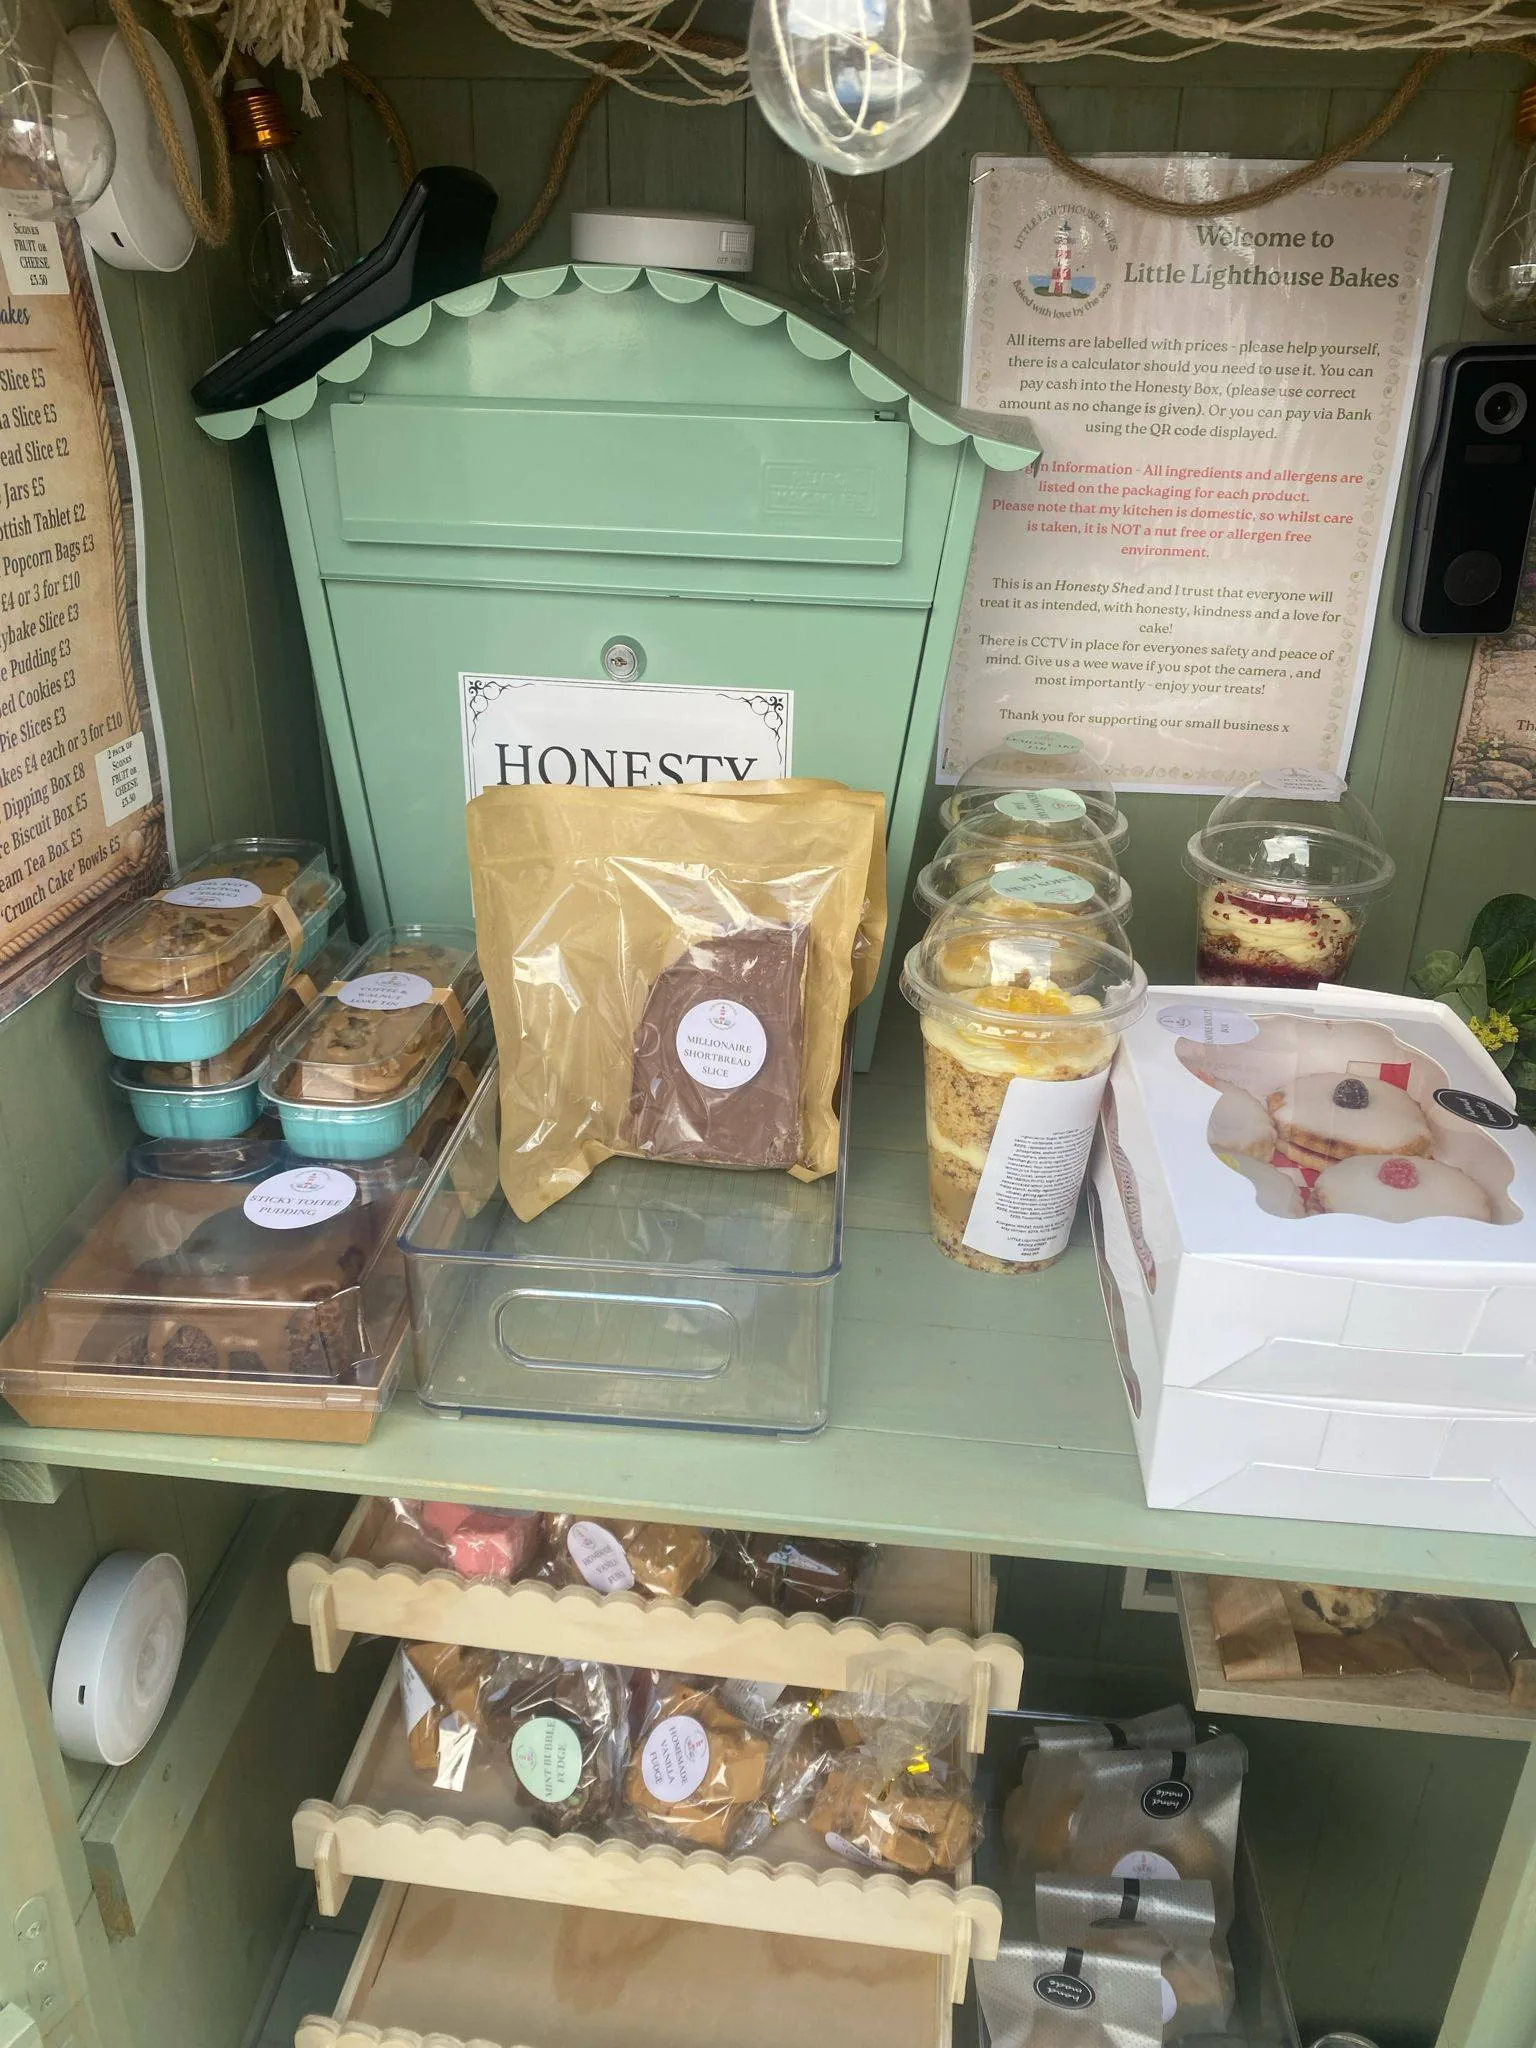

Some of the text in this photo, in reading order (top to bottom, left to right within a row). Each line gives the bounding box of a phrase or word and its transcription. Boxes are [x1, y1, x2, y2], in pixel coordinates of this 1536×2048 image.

[1196, 225, 1334, 248] Welcome to
[20, 256, 50, 268] CHEESE
[1124, 263, 1399, 288] Little Lighthouse Bakes
[1013, 280, 1112, 319] Baked with love by the sea
[1005, 332, 1380, 357] All items are labelled with prices please help yourself,
[0, 367, 46, 392] Slice £5
[1019, 377, 1356, 398] pay cash into the Honesty Box, (please use correct
[12, 403, 57, 428] Slice £5
[1084, 421, 1277, 440] using the QR code displayed.
[25, 440, 53, 463] Slice
[56, 437, 69, 457] £2
[4, 476, 46, 509] Jars £5
[1037, 480, 1310, 502] listed on the packaging for each product.
[34, 507, 71, 532] Tablet
[73, 503, 86, 522] £2
[4, 534, 95, 577] Popcorn Bags £3
[1121, 545, 1209, 558] environment.
[1, 570, 80, 613] £4 or 3 for £10
[0, 603, 79, 653] ybake Slice £3
[1138, 622, 1173, 634] cake!
[10, 638, 71, 678] Pudding £3
[0, 669, 76, 717] ed Cookies £3
[1034, 675, 1266, 695] most importantly enjoy your treats!
[0, 706, 66, 753] Pie Slices £3
[998, 708, 1290, 733] Thank you for supporting our small business x
[1516, 719, 1536, 731] Th
[25, 753, 38, 775] £4
[40, 740, 66, 767] each
[67, 737, 79, 753] or
[80, 729, 88, 746] 3
[89, 723, 104, 742] for
[106, 711, 123, 733] £10
[495, 743, 758, 787] HONESTY
[5, 762, 86, 820] Dipping Box £8
[115, 777, 139, 797] CHEESE
[11, 815, 52, 852] Biscuit
[53, 803, 75, 827] Box
[75, 792, 88, 813] £5
[24, 854, 46, 877] Tea
[49, 839, 71, 863] Box
[71, 828, 83, 848] £5
[78, 844, 108, 875] Bowls
[108, 835, 121, 854] £5
[686, 1035, 753, 1054] MILLIONAIRE
[684, 1049, 751, 1067] SHORTBREAD
[701, 1065, 729, 1078] SLICE
[1455, 1096, 1479, 1118] hand
[249, 1195, 344, 1207] STICKY TOFFEE
[258, 1206, 318, 1216] PUDDING
[543, 1719, 556, 1798] MINT BUBBLE
[556, 1742, 567, 1784] FUDGE
[649, 1751, 664, 1785] FUDGE
[660, 1739, 676, 1785] VANILLA
[668, 1726, 689, 1786] HOMEMADE
[1152, 1799, 1180, 1809] hand
[1155, 1789, 1184, 1798] made
[1047, 1987, 1080, 2002] hand
[1048, 1980, 1083, 1993] made
